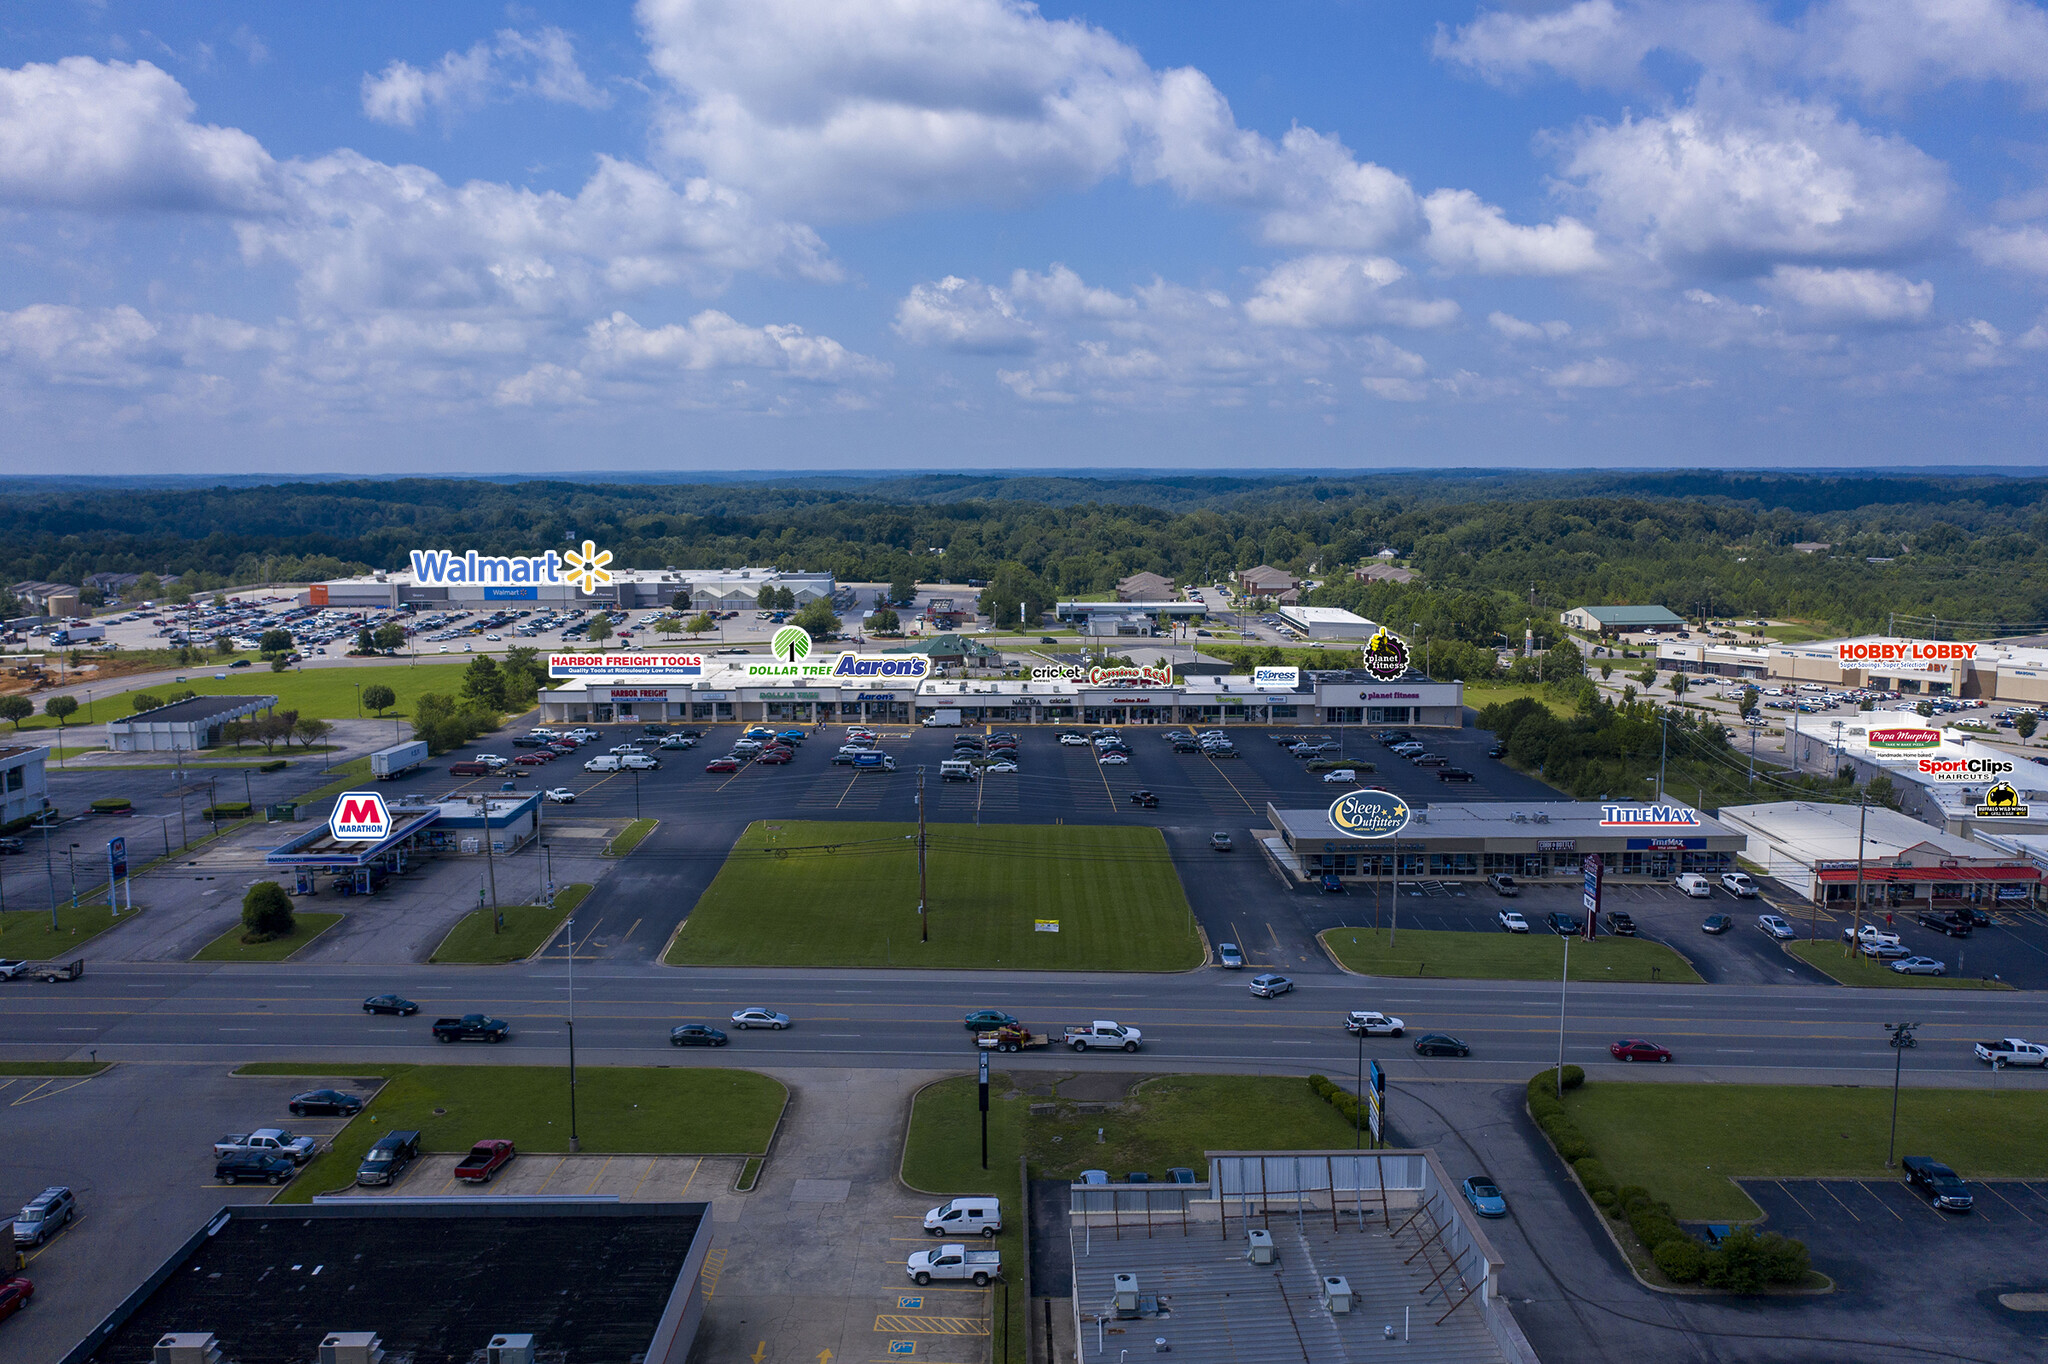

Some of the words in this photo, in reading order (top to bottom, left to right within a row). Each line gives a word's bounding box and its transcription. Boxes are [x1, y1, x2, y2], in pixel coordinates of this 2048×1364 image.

[611, 689, 638, 697] HARBOR
[639, 689, 668, 697] FREIGHT
[857, 692, 895, 701] Aaron's
[1368, 692, 1393, 700] planet
